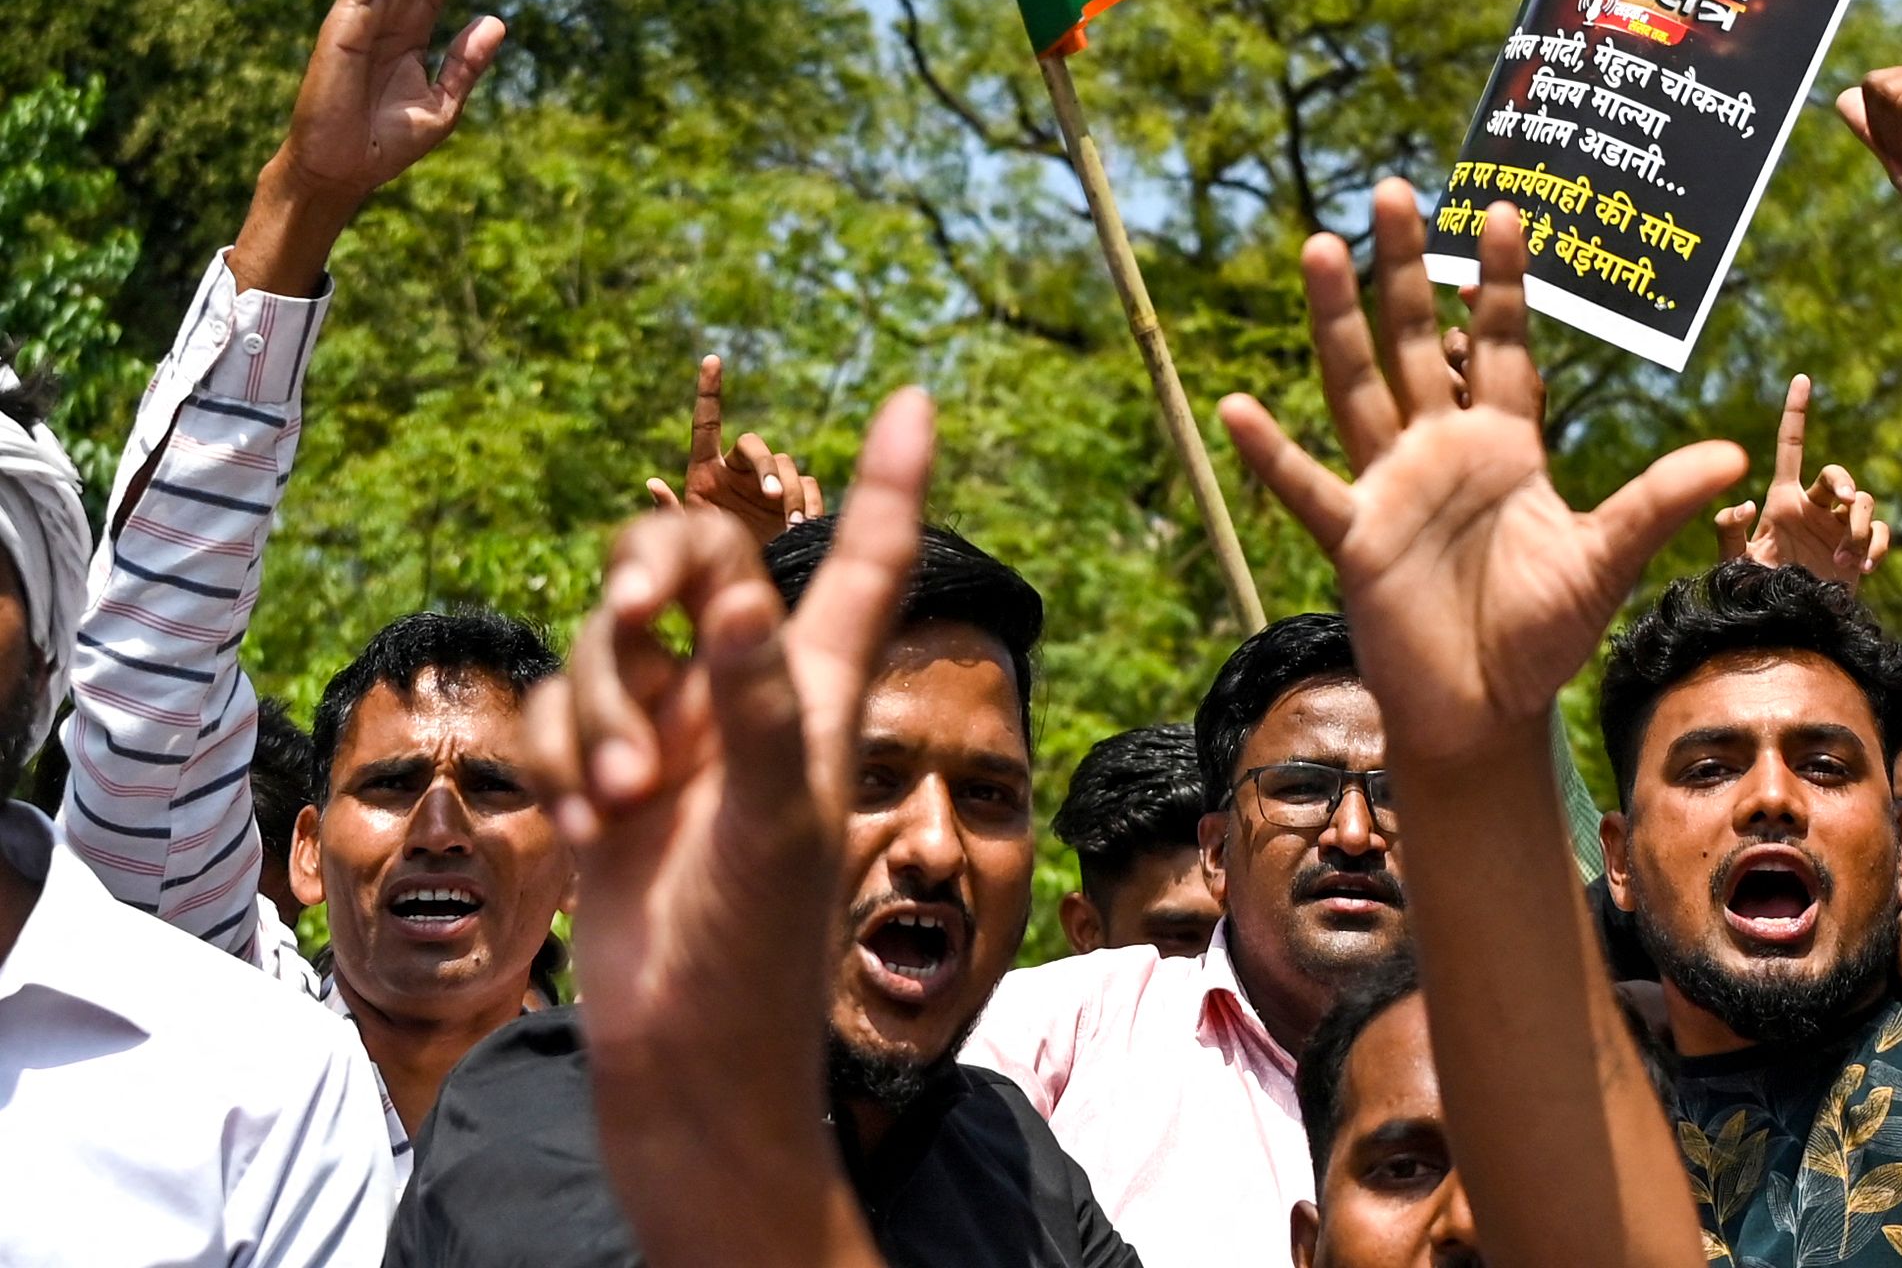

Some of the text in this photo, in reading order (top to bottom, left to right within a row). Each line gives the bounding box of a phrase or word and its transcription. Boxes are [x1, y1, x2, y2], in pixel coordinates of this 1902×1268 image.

[1504, 26, 1757, 139] नीरव मोदी, मेहुल चौकसी,
[1527, 66, 1672, 140] विजय माल्या
[1486, 99, 1686, 196] और गौतम अडानी...
[1436, 198, 1472, 236] मोदी
[1471, 209, 1489, 237] रा
[1528, 213, 1554, 256] है
[1448, 161, 1701, 261] इन पर कार्यवाही की सोच
